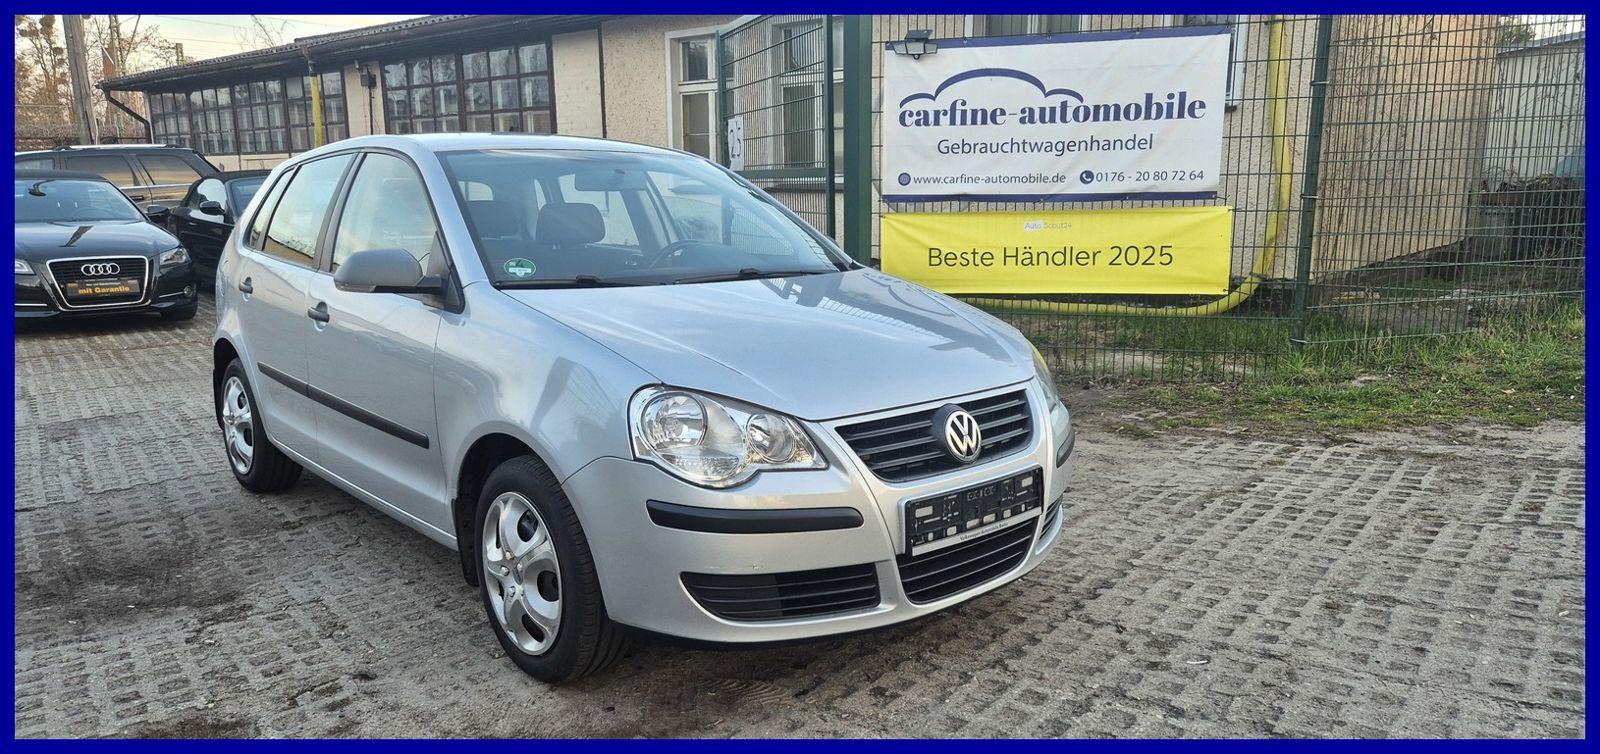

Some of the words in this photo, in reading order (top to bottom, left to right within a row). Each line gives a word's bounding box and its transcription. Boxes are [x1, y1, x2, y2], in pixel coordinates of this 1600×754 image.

[898, 90, 1207, 128] carfine-automobile
[937, 133, 1154, 157] Gebrauchtwagenhandel
[913, 172, 1067, 185] www.carfine-automobile.de
[1096, 171, 1125, 182] 0176
[1135, 170, 1150, 182] 20
[1152, 170, 1168, 182] 80
[1171, 170, 1186, 181] 72
[1189, 170, 1204, 181] 64
[928, 247, 995, 267] Beste
[1003, 246, 1101, 267] Händler
[1108, 245, 1173, 266] 2025
[95, 285, 130, 294] Garantie
